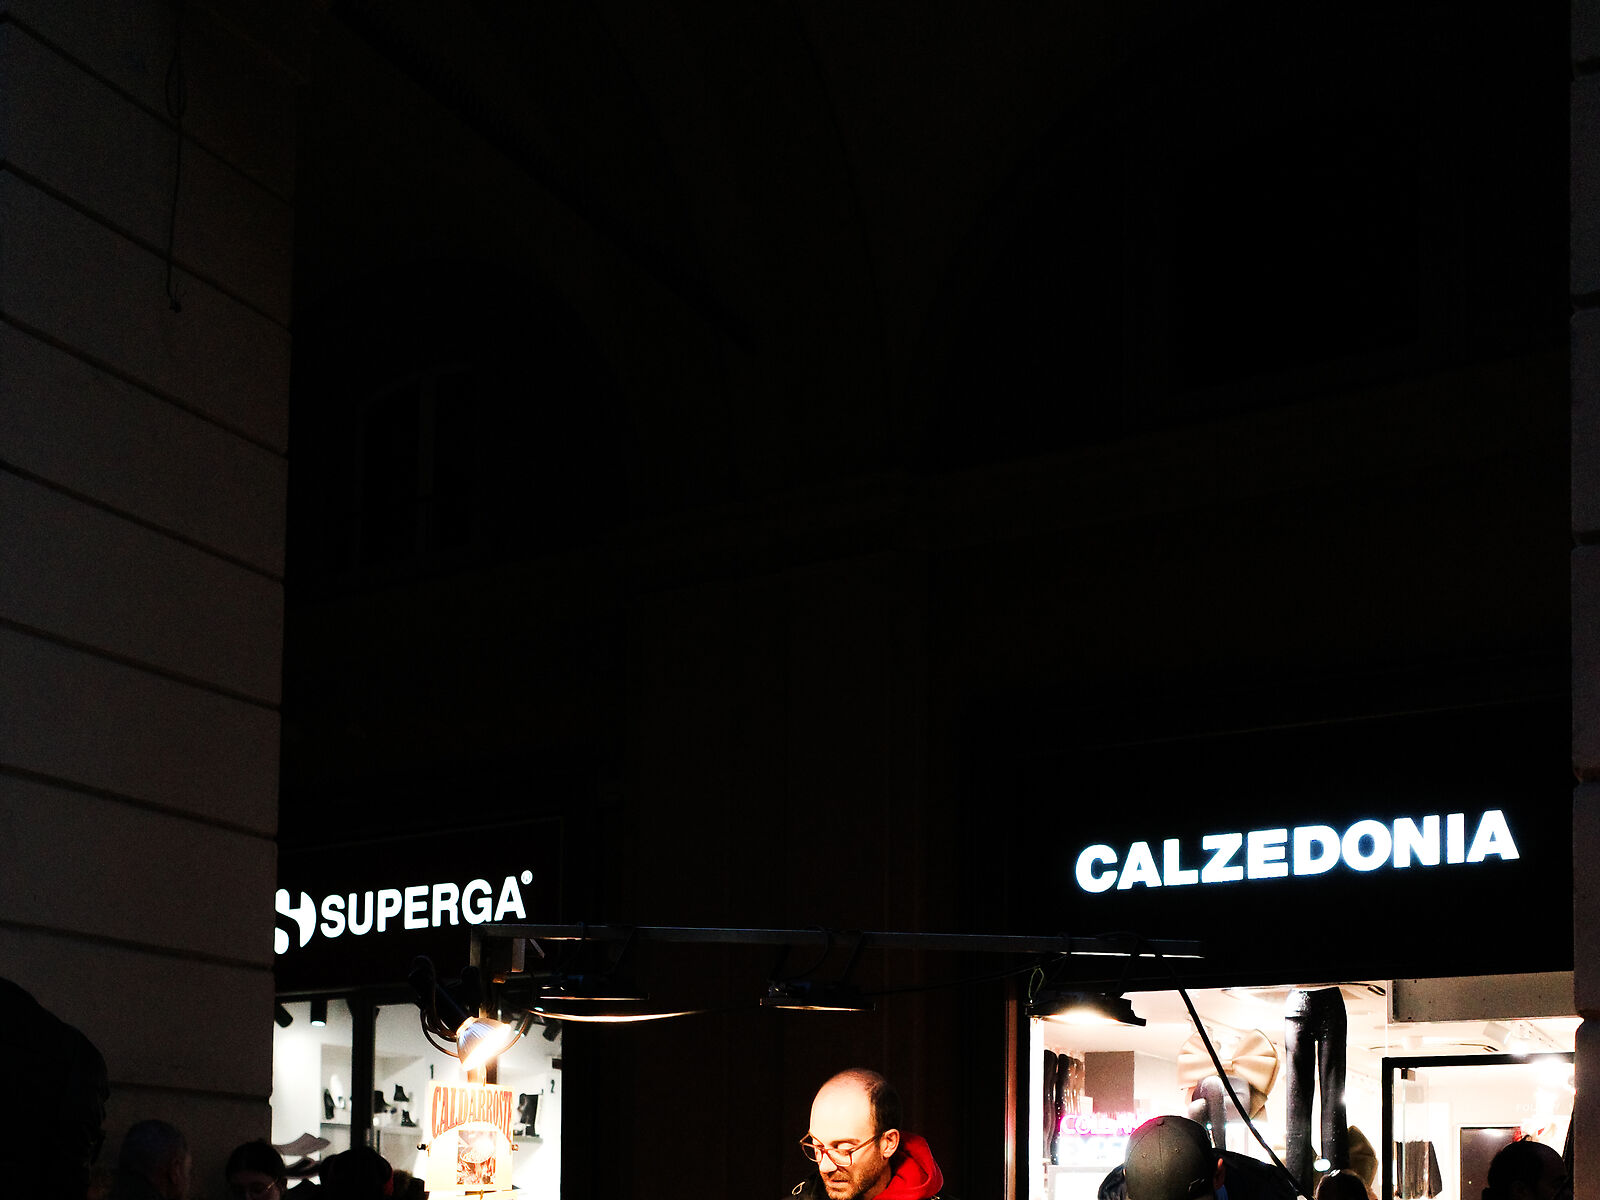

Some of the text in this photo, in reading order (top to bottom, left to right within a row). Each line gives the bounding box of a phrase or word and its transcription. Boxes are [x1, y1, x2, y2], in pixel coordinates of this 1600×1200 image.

[1075, 809, 1520, 893] CALZEDONIA
[320, 876, 527, 939] SUPERGA
[432, 1086, 512, 1143] CALDARROSTE
